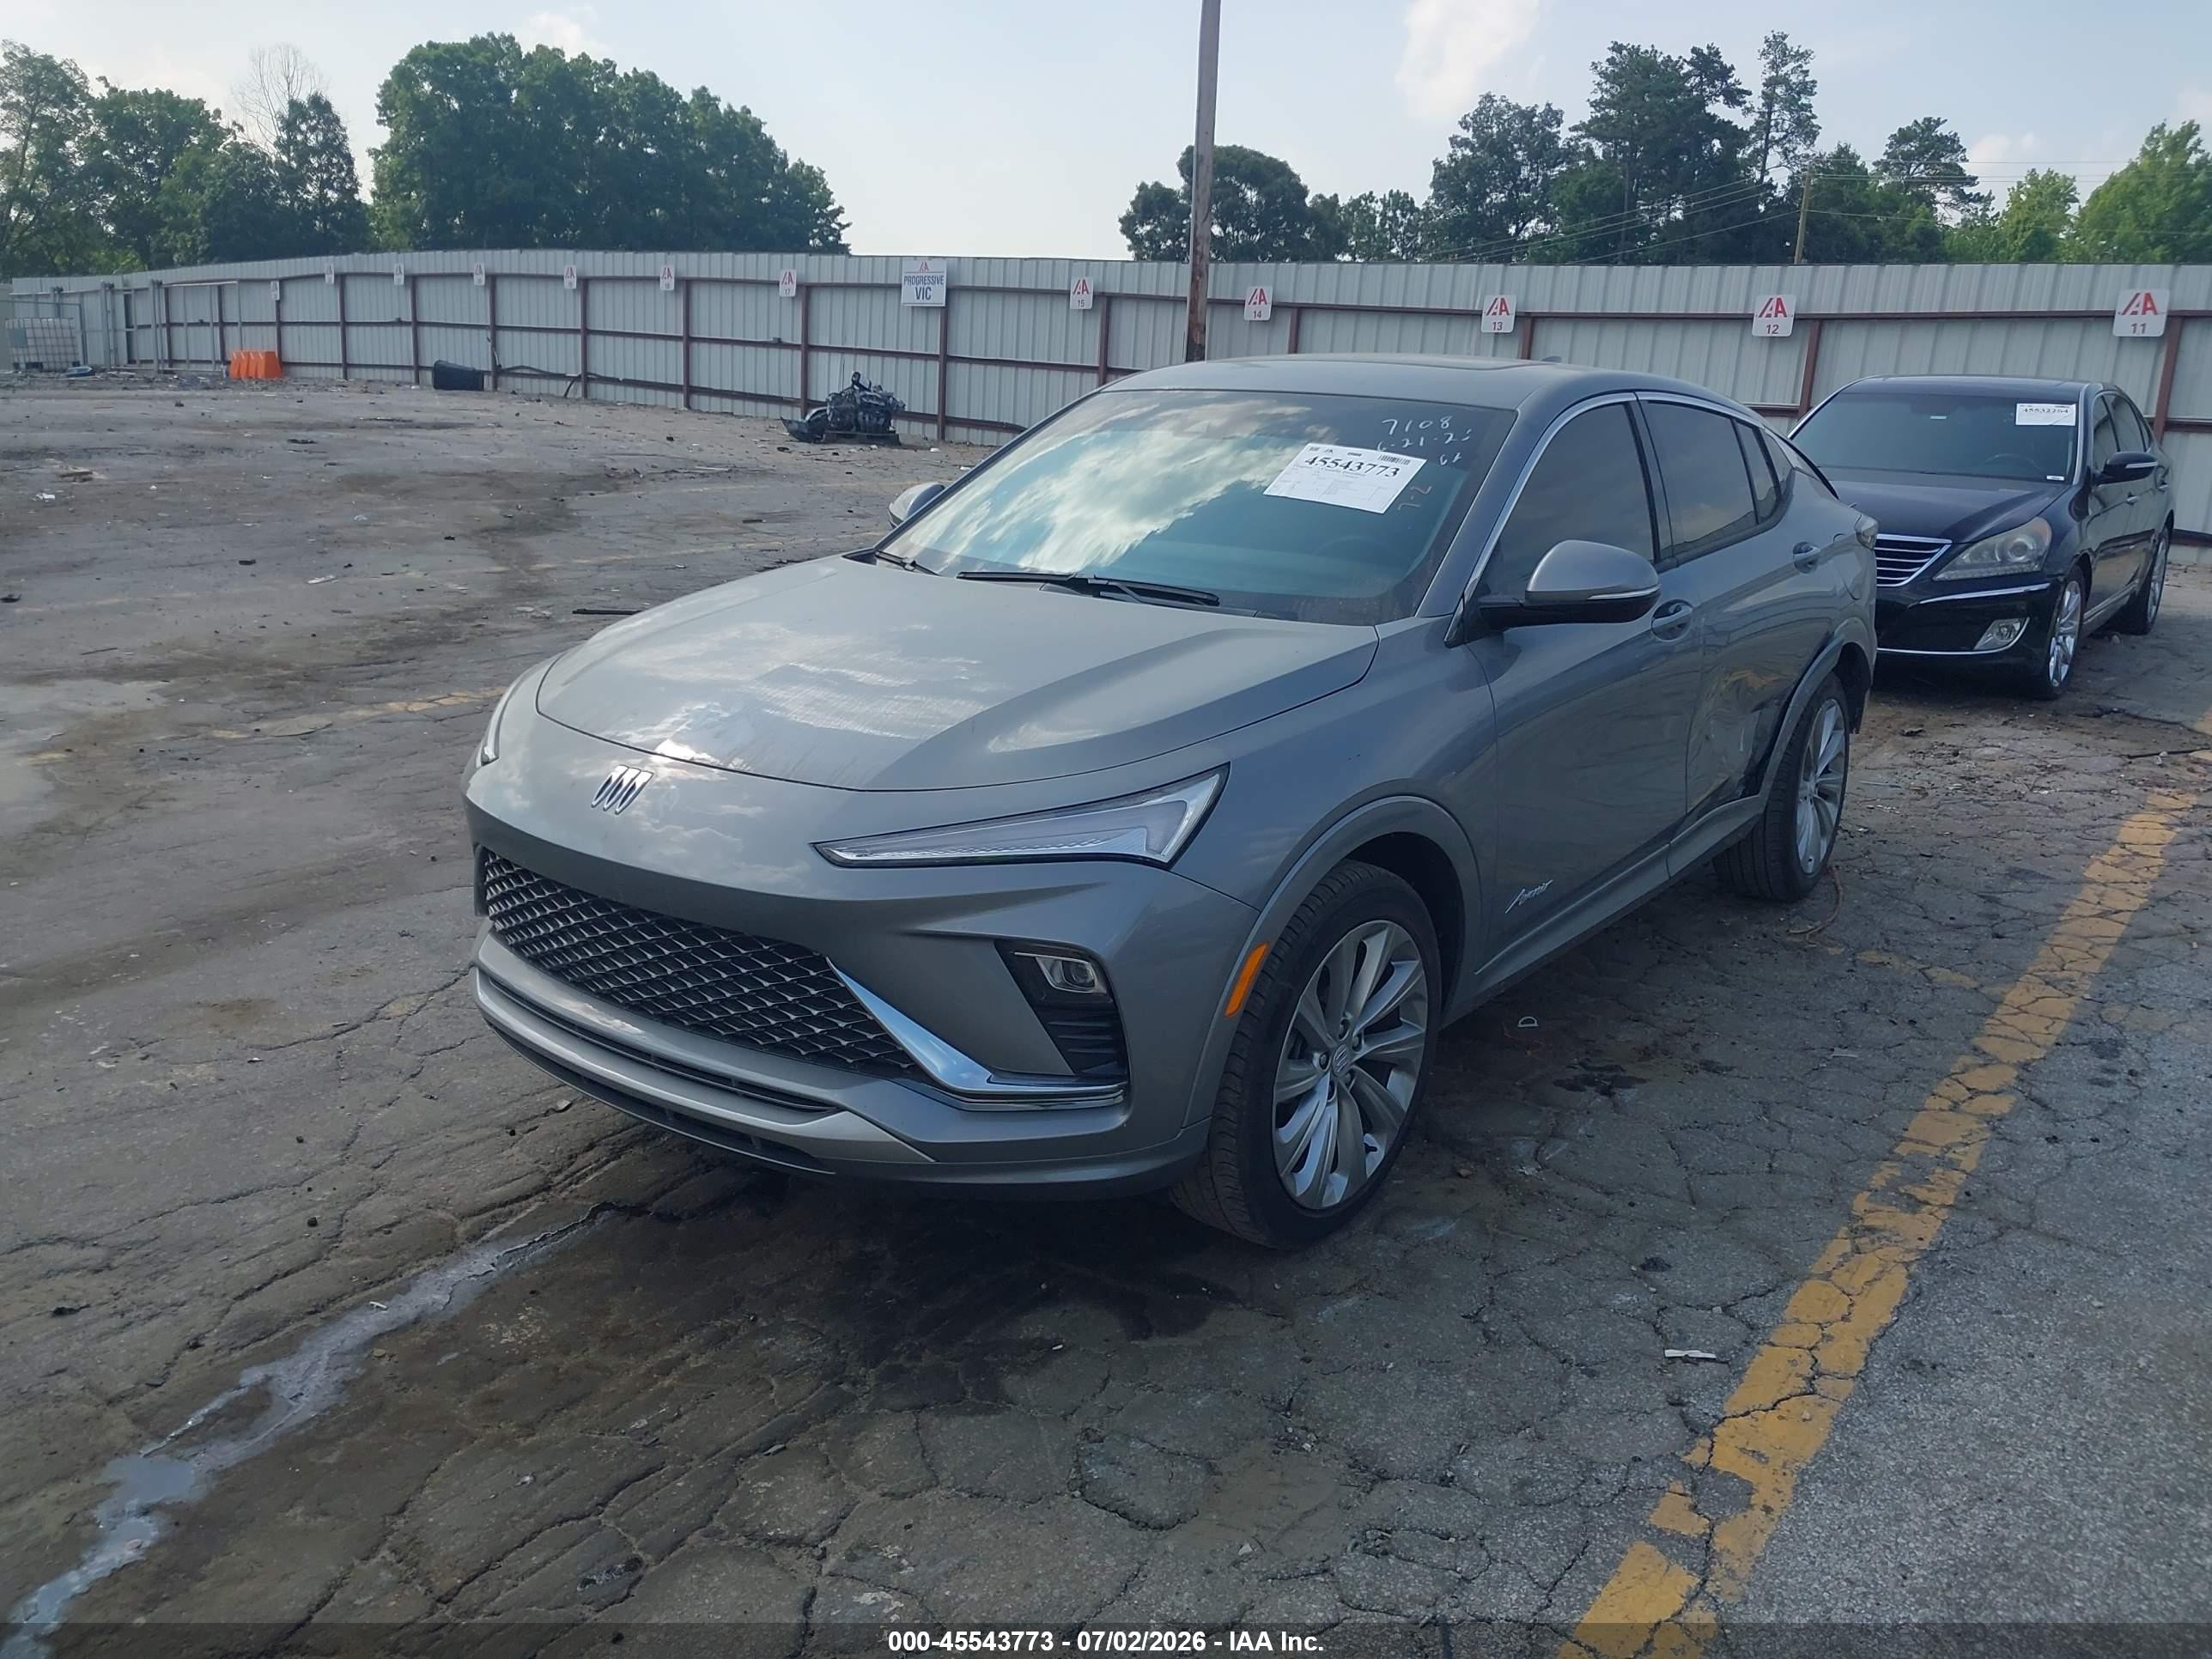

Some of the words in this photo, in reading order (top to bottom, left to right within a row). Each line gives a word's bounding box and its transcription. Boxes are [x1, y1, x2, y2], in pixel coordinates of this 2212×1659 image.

[903, 275, 945, 285] PROGRESSIVE
[915, 287, 932, 301] VIC
[1078, 299, 1085, 308] 15
[1254, 310, 1262, 319] 14
[1492, 321, 1503, 331] 13
[1765, 324, 1779, 334] 12
[2130, 323, 2147, 334] 11
[1381, 416, 1453, 435] 7108
[1304, 456, 1401, 477] 45543773
